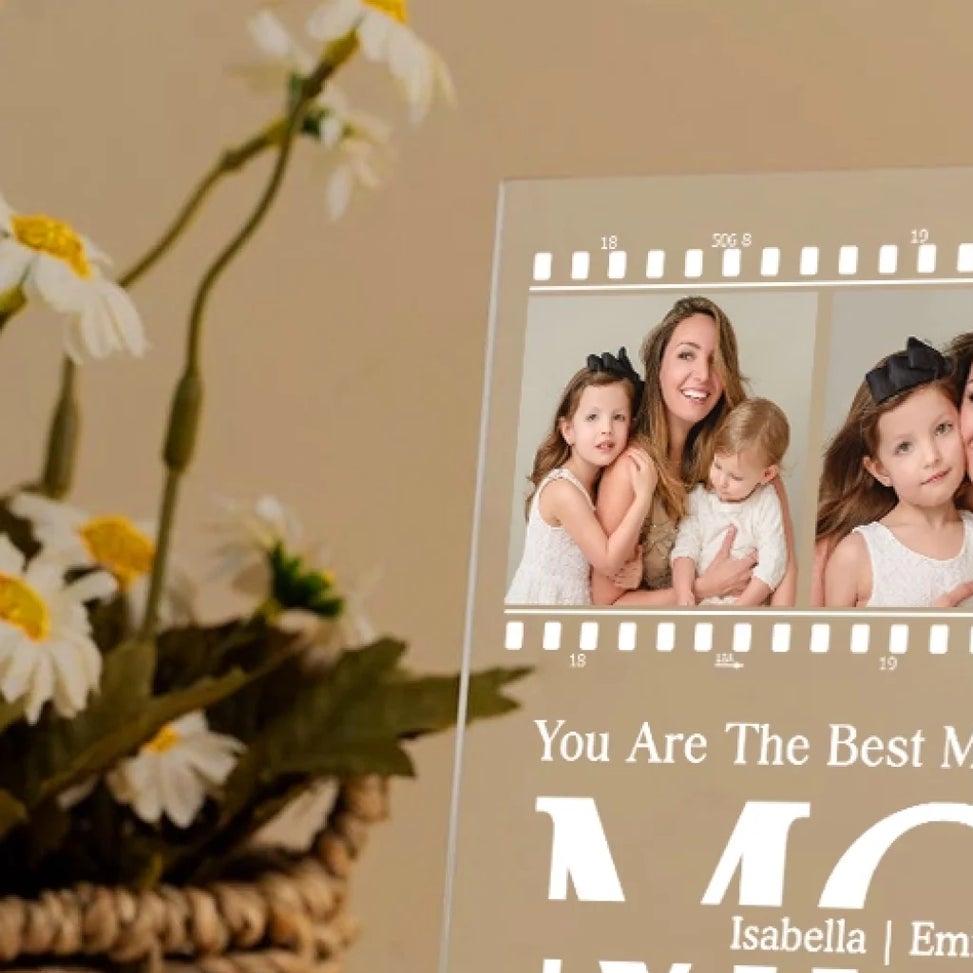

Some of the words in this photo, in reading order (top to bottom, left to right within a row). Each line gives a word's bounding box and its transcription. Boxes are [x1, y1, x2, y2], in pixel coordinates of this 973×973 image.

[600, 235, 618, 250] 18
[911, 229, 929, 244] 19
[569, 653, 587, 668] 18
[878, 655, 898, 671] 19
[534, 719, 610, 763] You
[625, 721, 708, 764] Are
[724, 723, 811, 766] The
[826, 723, 925, 768] Best
[729, 915, 867, 954] Isabella
